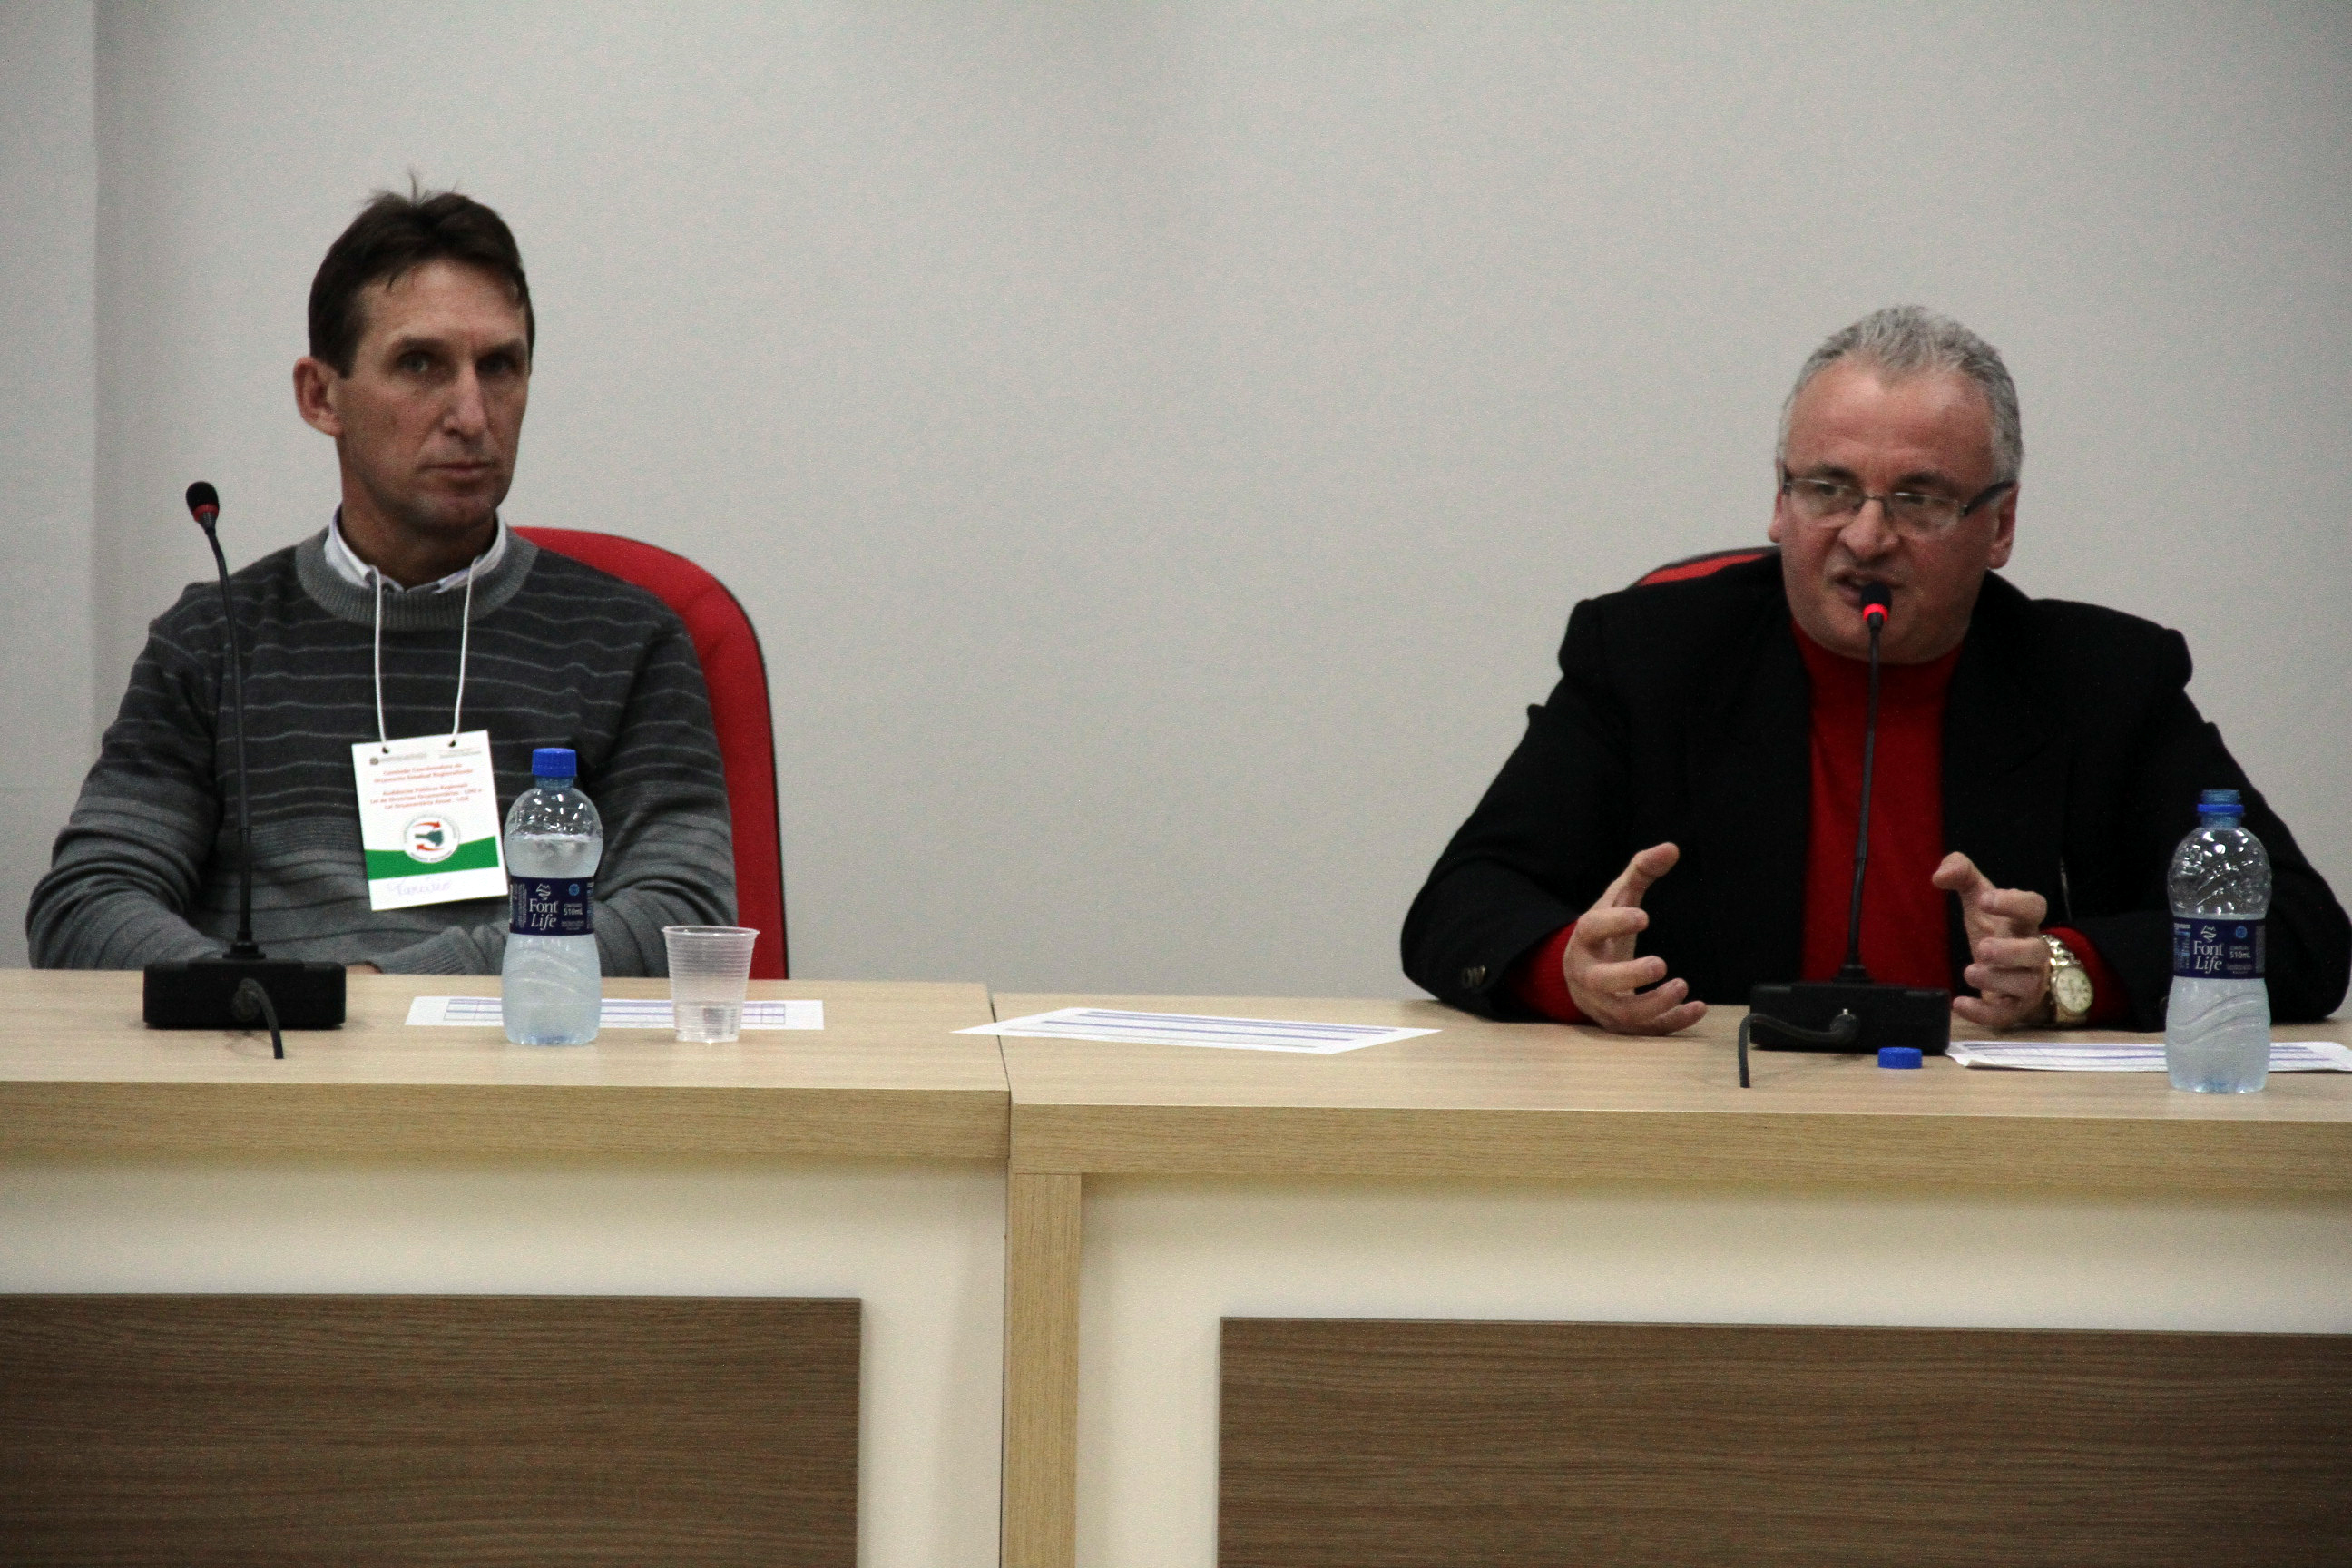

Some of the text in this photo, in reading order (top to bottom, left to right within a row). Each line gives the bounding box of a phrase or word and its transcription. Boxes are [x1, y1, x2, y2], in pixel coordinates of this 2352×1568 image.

[529, 898, 559, 914] Font
[530, 913, 557, 931] Life
[2193, 940, 2225, 956] Font
[2194, 956, 2223, 974] Life
